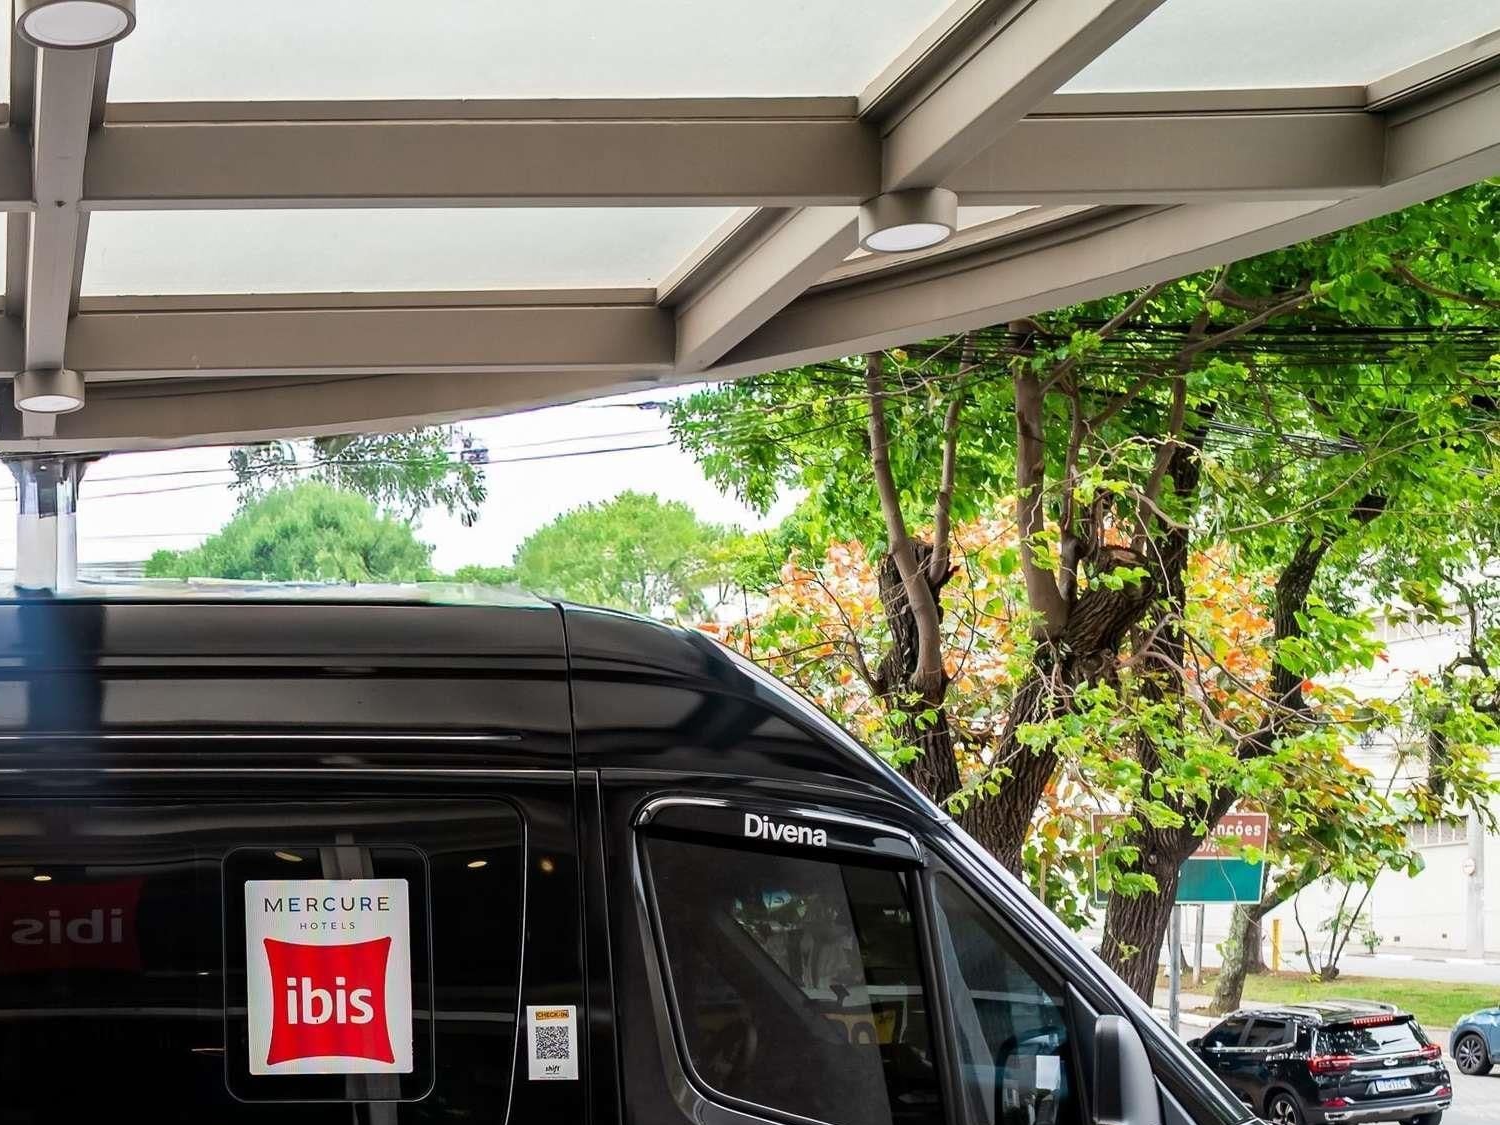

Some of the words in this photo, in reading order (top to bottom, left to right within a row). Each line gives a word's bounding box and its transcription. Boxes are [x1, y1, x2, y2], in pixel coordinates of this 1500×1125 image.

[744, 813, 827, 847] Divena
[264, 896, 389, 913] MERCURE
[300, 921, 355, 930] HOTELS
[285, 976, 374, 1025] ibis
